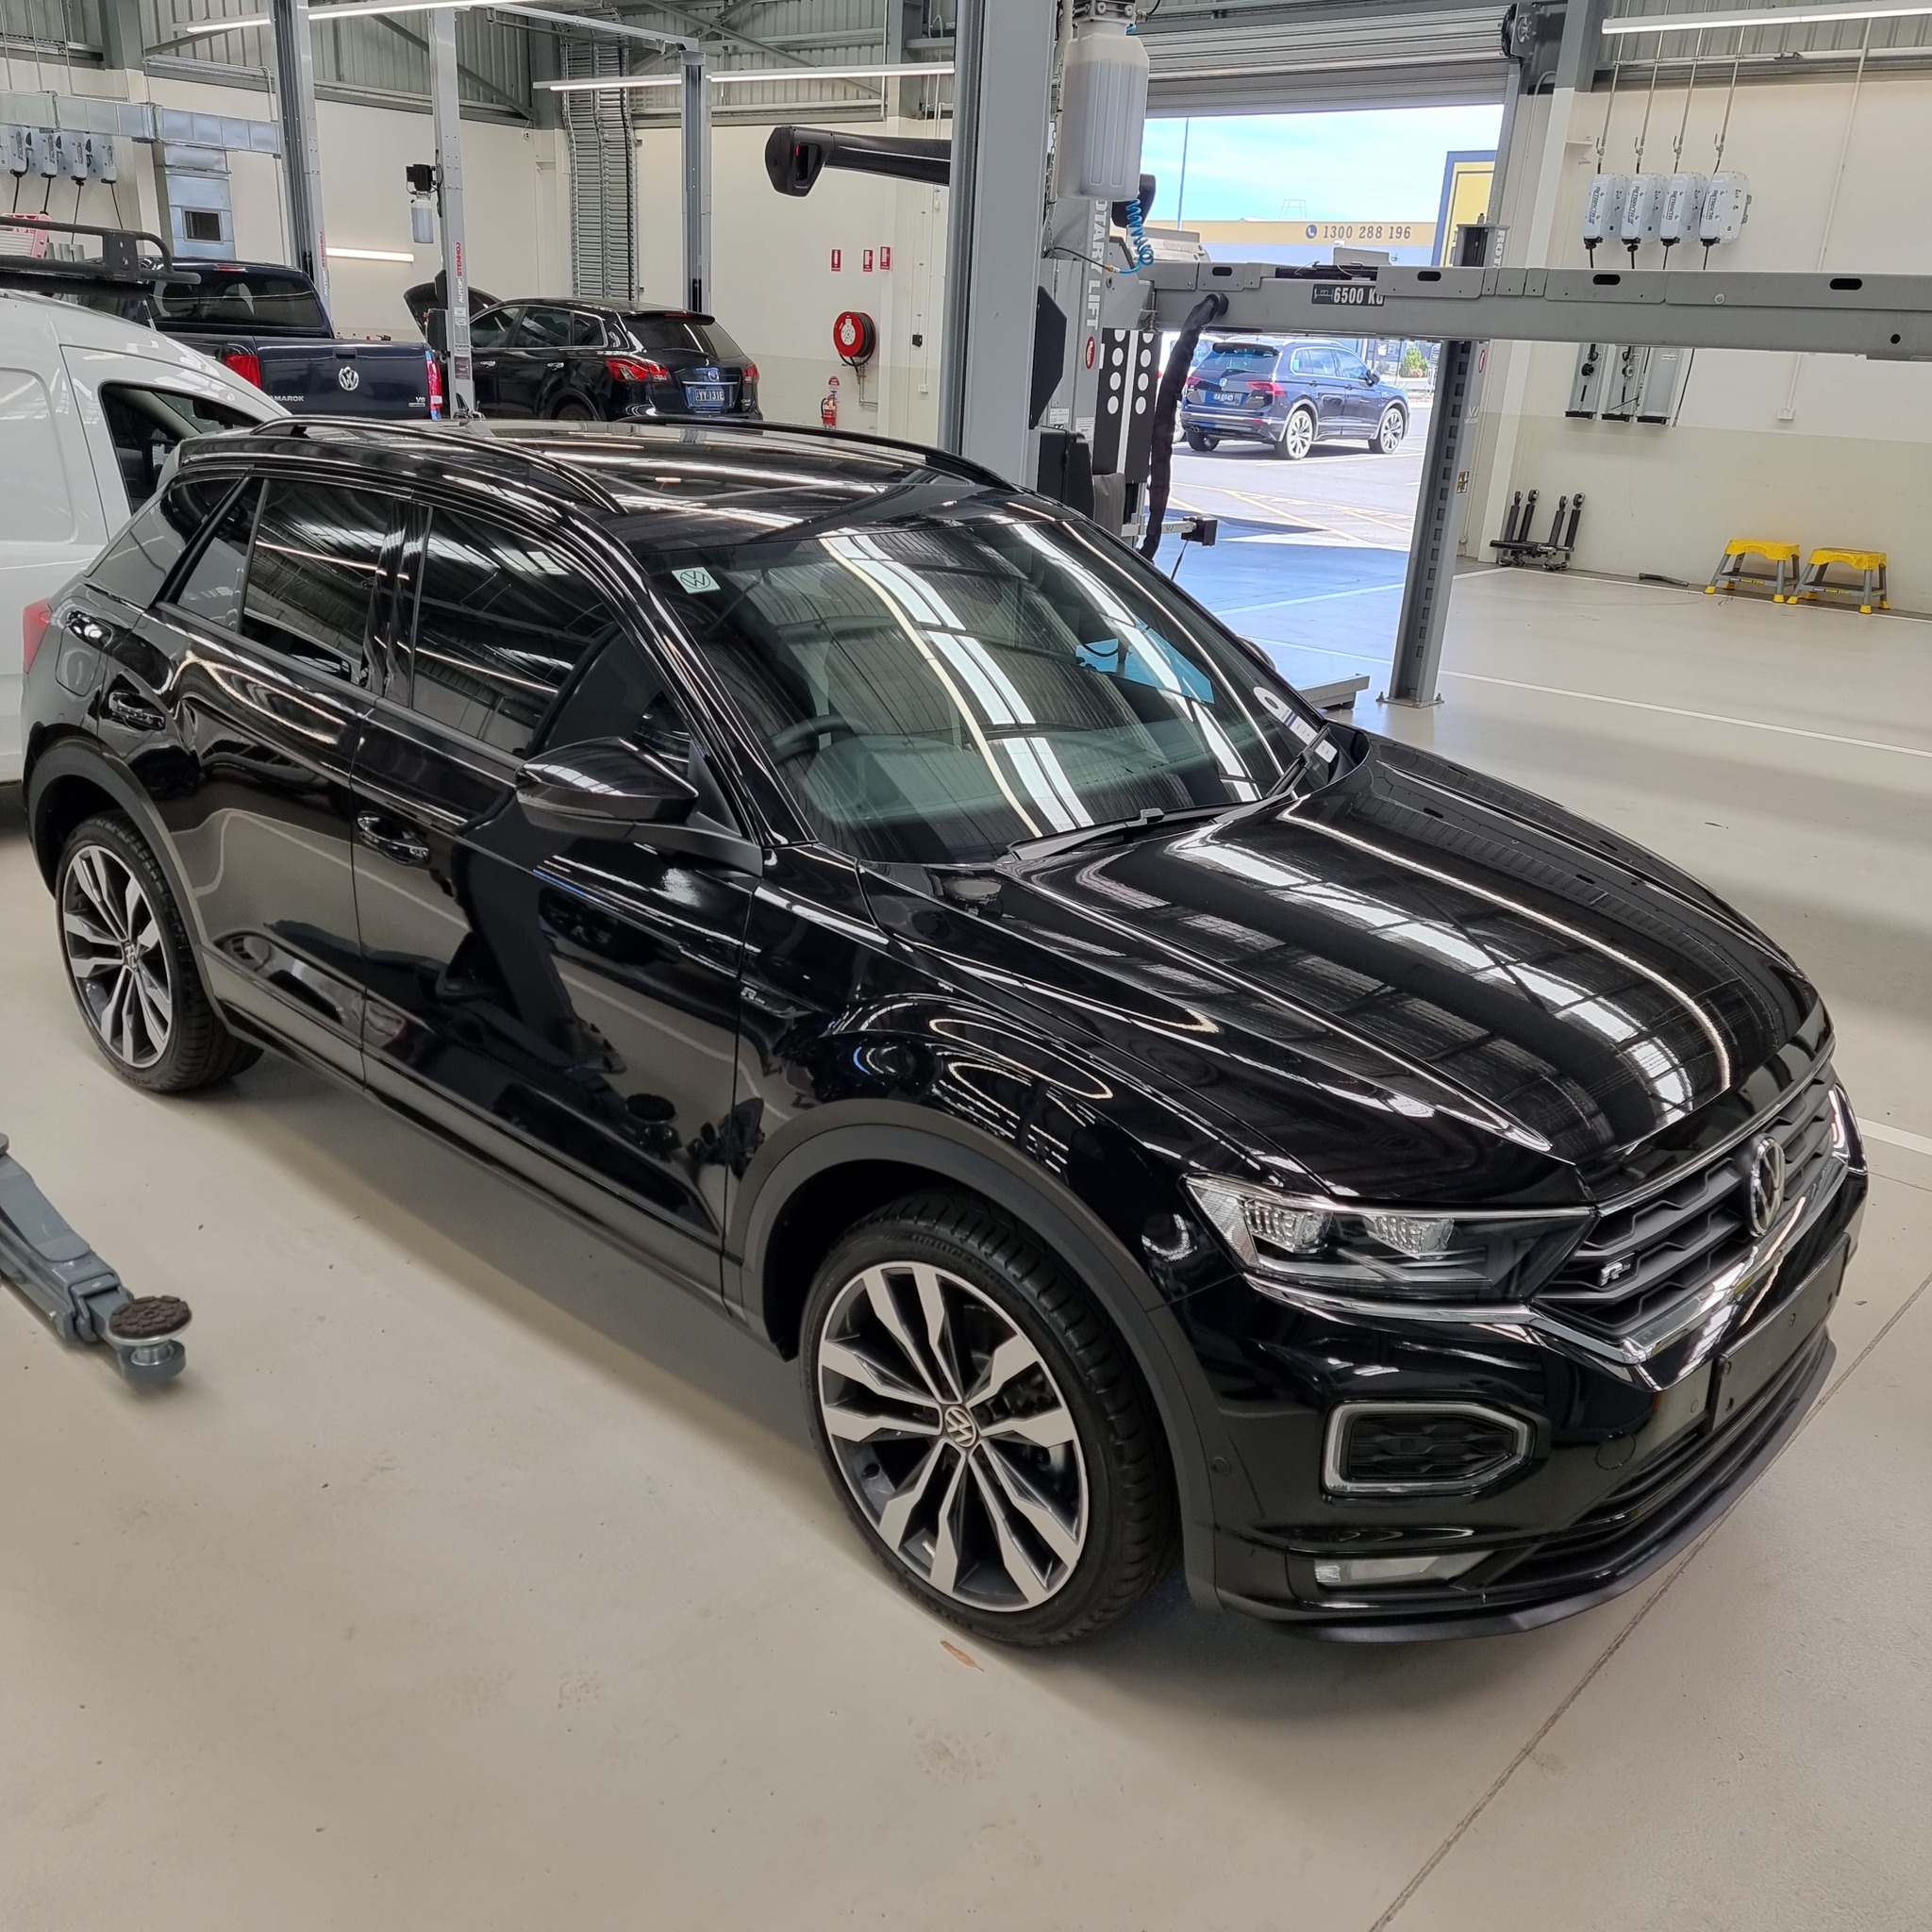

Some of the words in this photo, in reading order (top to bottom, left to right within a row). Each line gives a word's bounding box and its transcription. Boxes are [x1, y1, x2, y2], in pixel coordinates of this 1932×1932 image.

[1091, 200, 1108, 275] OTARY
[1324, 225, 1353, 239] 1300
[1358, 225, 1383, 239] 288
[1389, 226, 1411, 239] 196
[1492, 230, 1506, 268] ROT
[1086, 280, 1101, 330] LIFT
[1333, 287, 1364, 304] 6500
